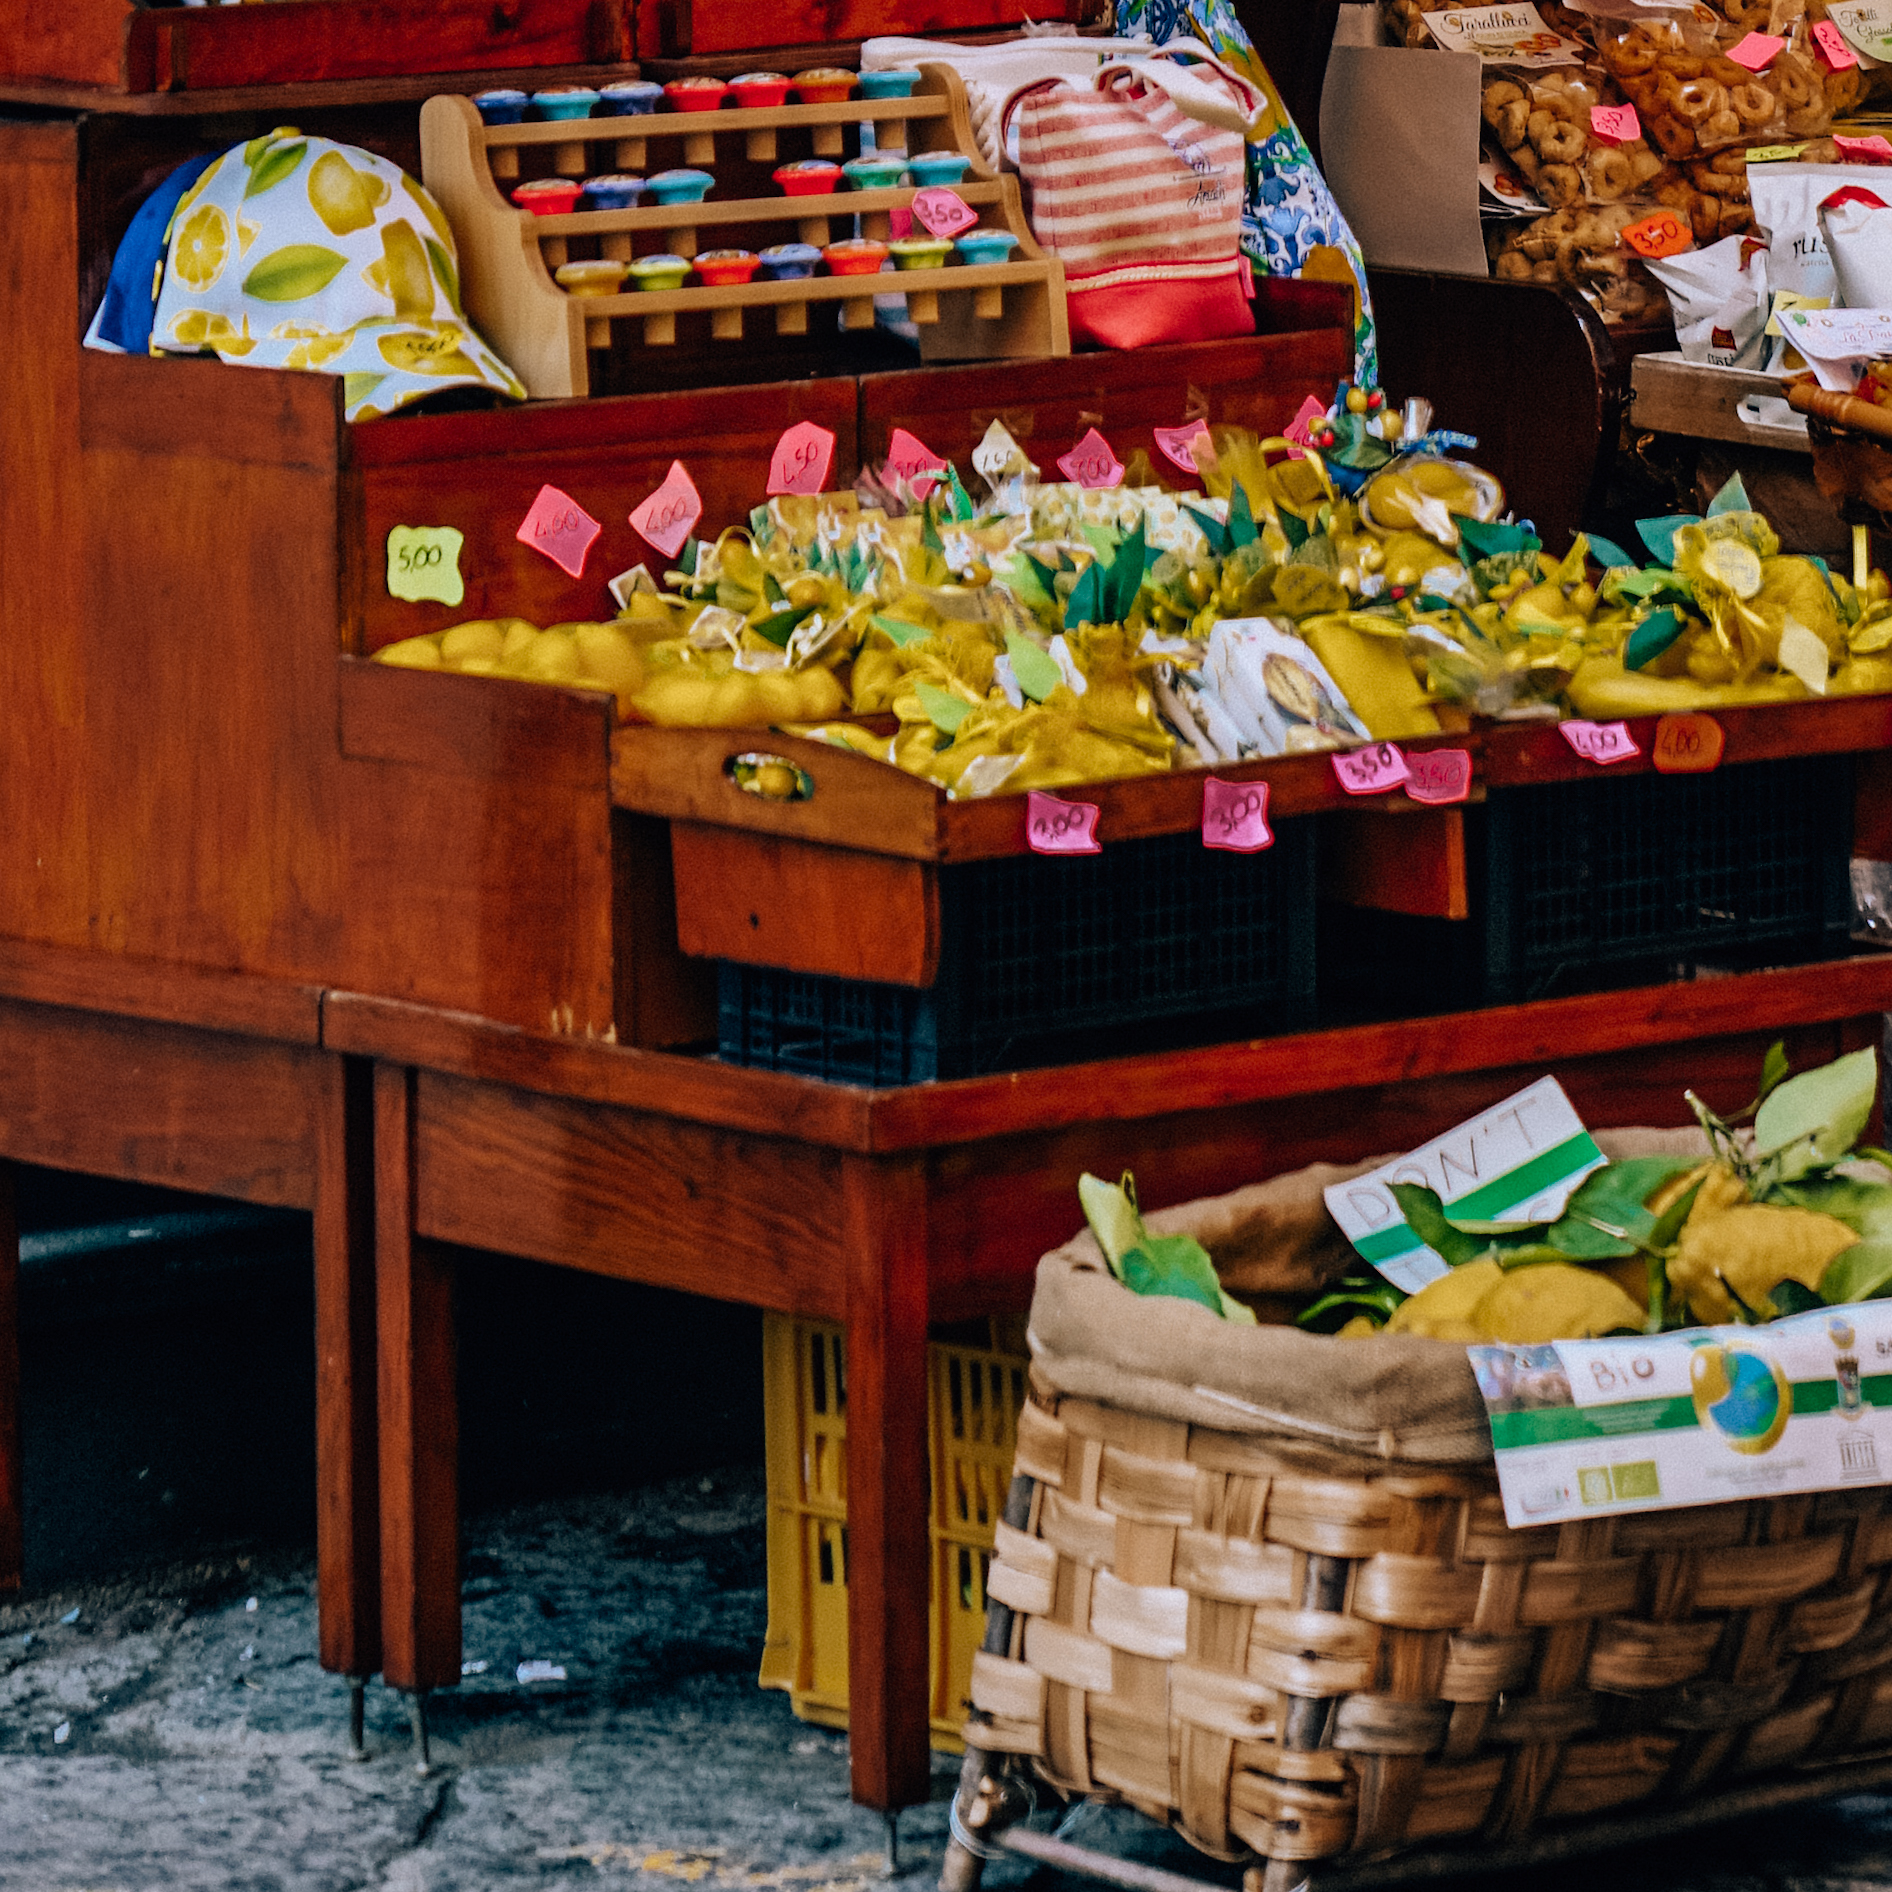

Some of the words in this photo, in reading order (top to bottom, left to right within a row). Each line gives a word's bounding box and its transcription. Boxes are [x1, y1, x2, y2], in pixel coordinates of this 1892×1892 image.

[1455, 6, 1533, 35] Tarallucci
[1635, 220, 1678, 249] 3,50
[398, 543, 444, 571] 5,00
